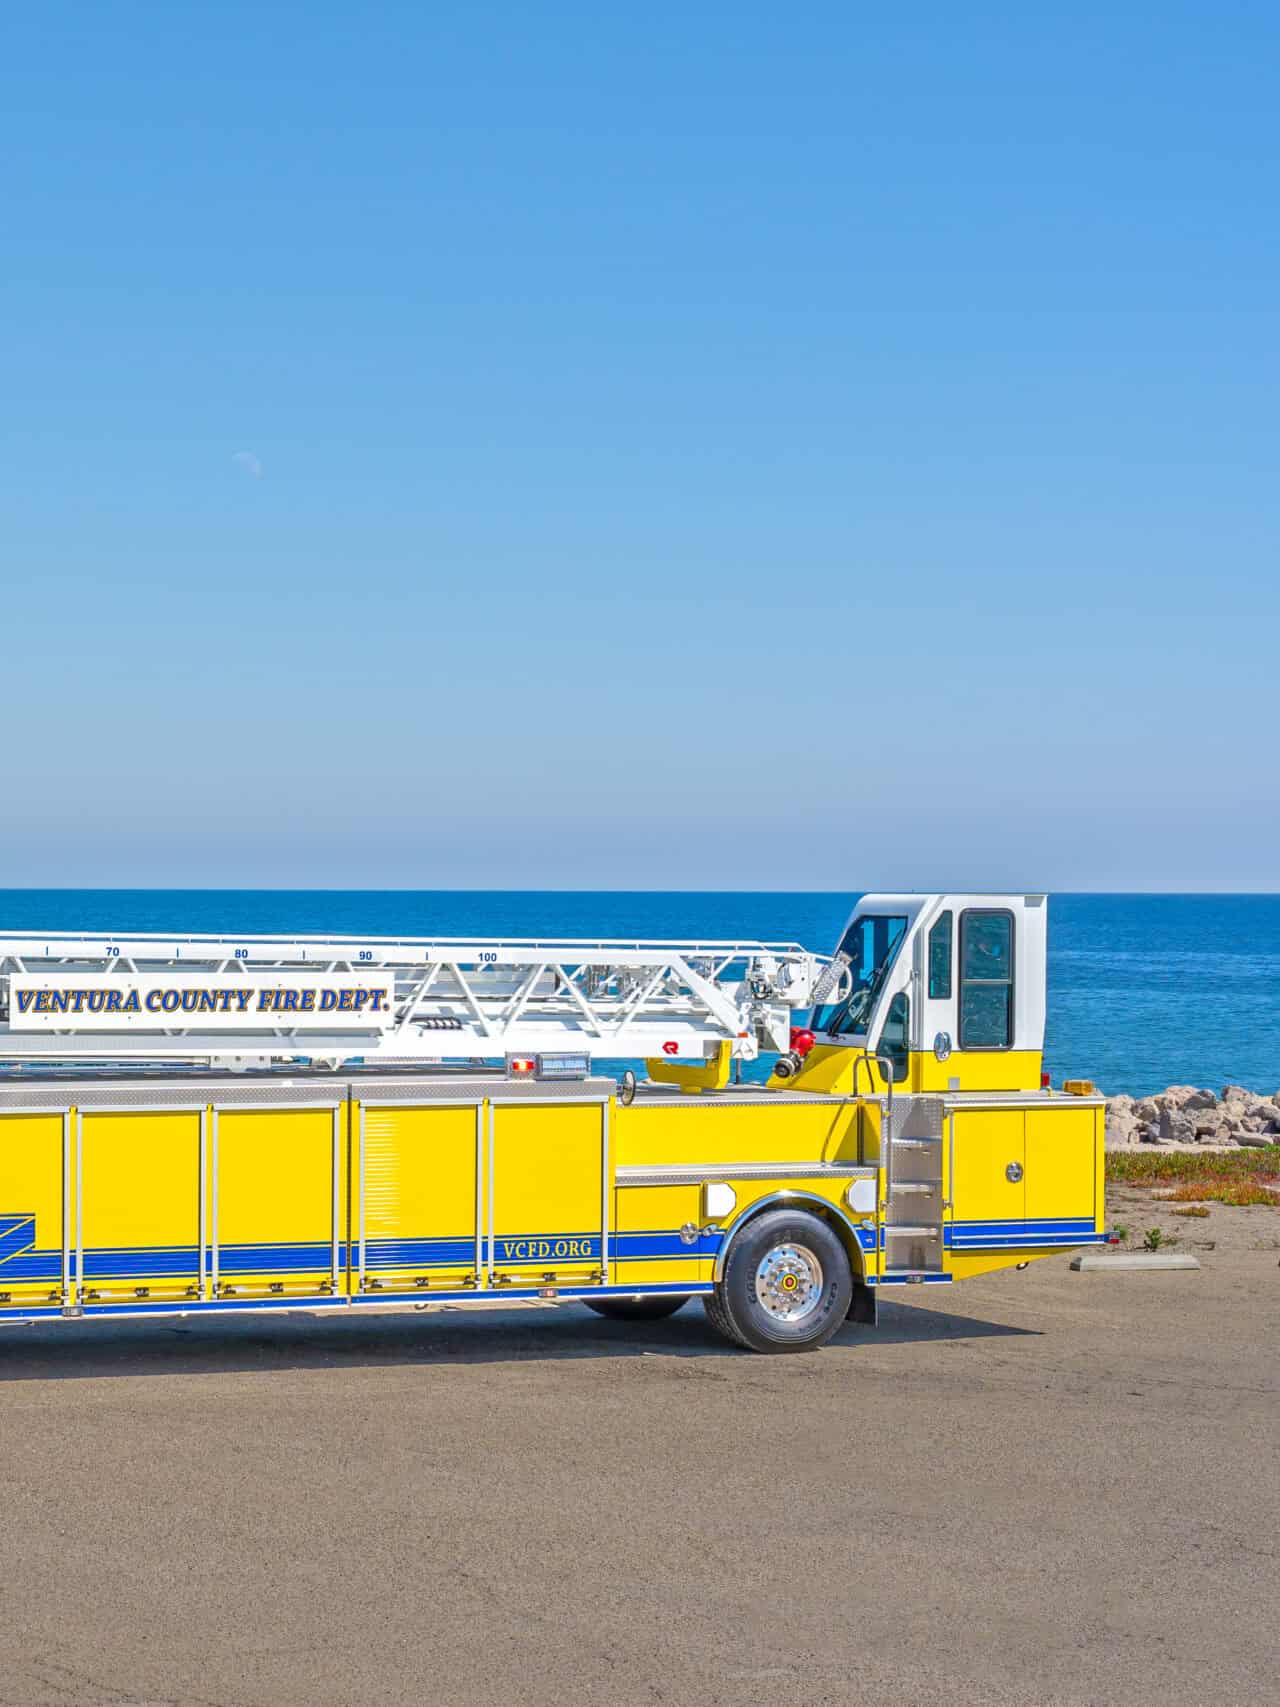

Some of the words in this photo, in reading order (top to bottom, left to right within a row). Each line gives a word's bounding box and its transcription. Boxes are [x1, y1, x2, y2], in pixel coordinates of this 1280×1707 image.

[105, 946, 120, 957] 70
[234, 948, 249, 959] 80
[358, 950, 373, 961] 90
[477, 951, 497, 962] 100
[15, 989, 142, 1013] VENTURA
[144, 989, 255, 1013] COUNTY
[255, 988, 316, 1012] FIRE
[318, 988, 391, 1012] DEPT.
[503, 1240, 593, 1259] VCFD.ORG
